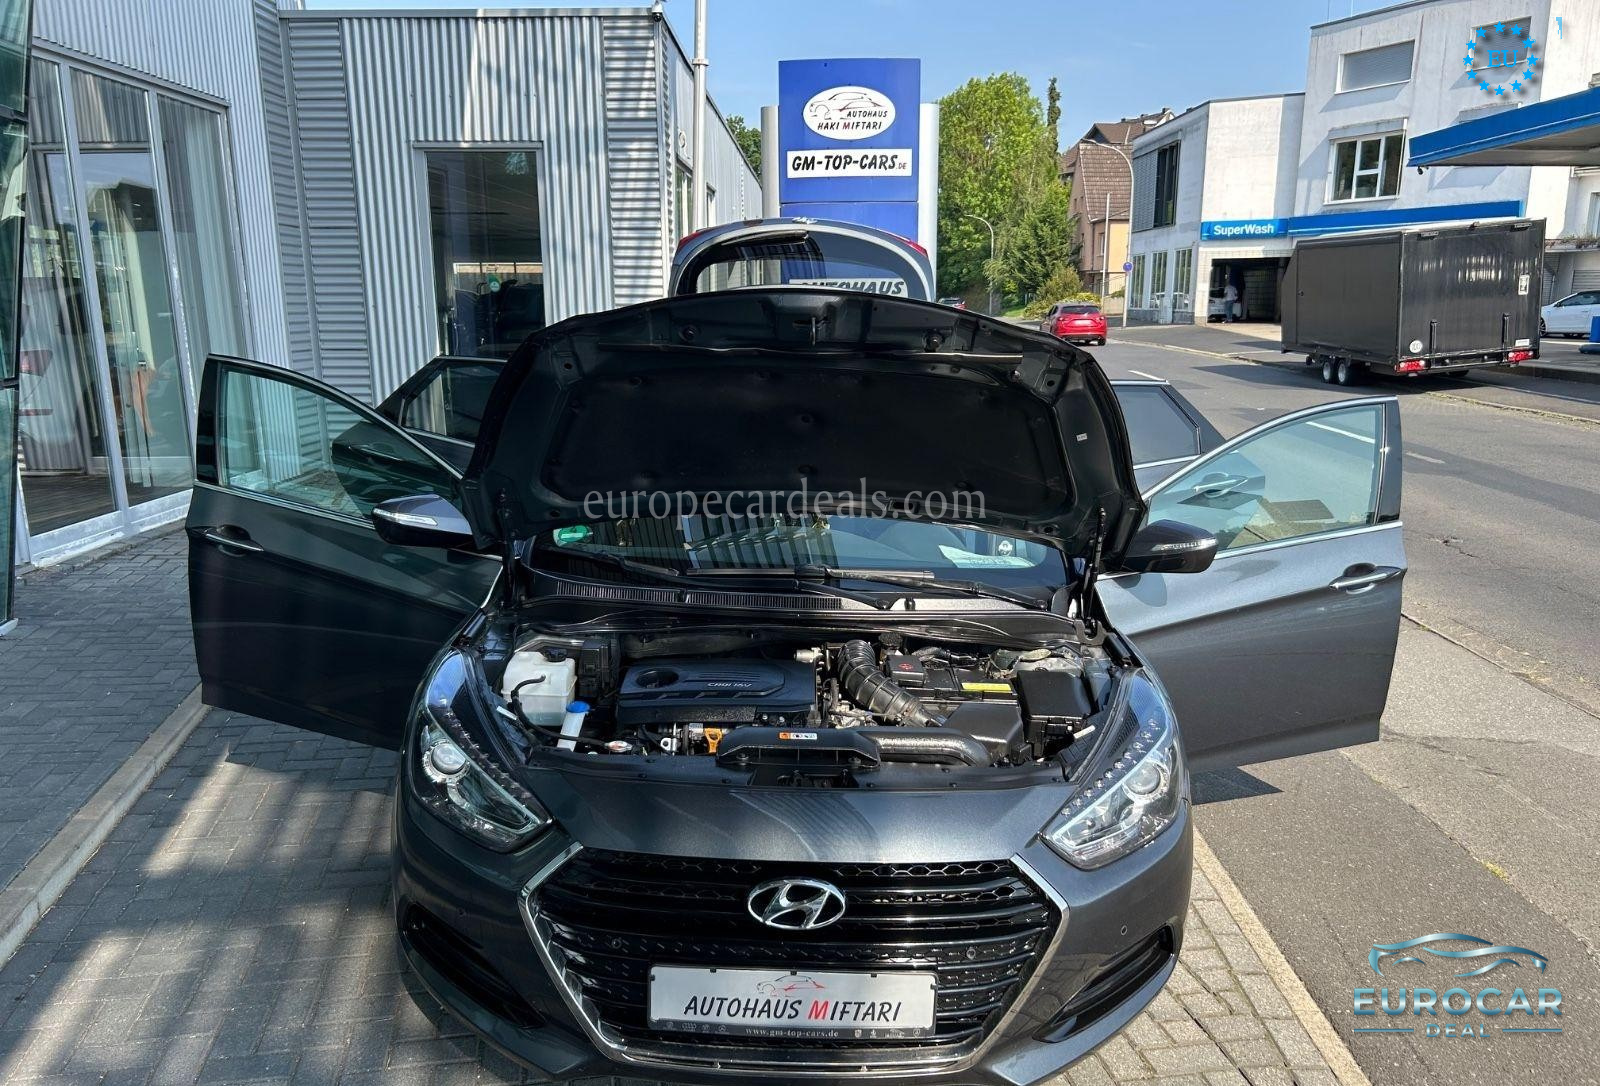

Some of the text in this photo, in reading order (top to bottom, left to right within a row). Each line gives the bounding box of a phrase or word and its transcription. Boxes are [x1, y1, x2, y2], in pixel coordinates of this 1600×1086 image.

[846, 110, 888, 119] AUTOHAUS
[817, 121, 882, 130] HAKI MIFTARI
[1213, 223, 1274, 236] SuperWash
[684, 995, 902, 1022] AUTOHAUS MIFTARI
[745, 1027, 839, 1038] www.gm-top-cars.de
